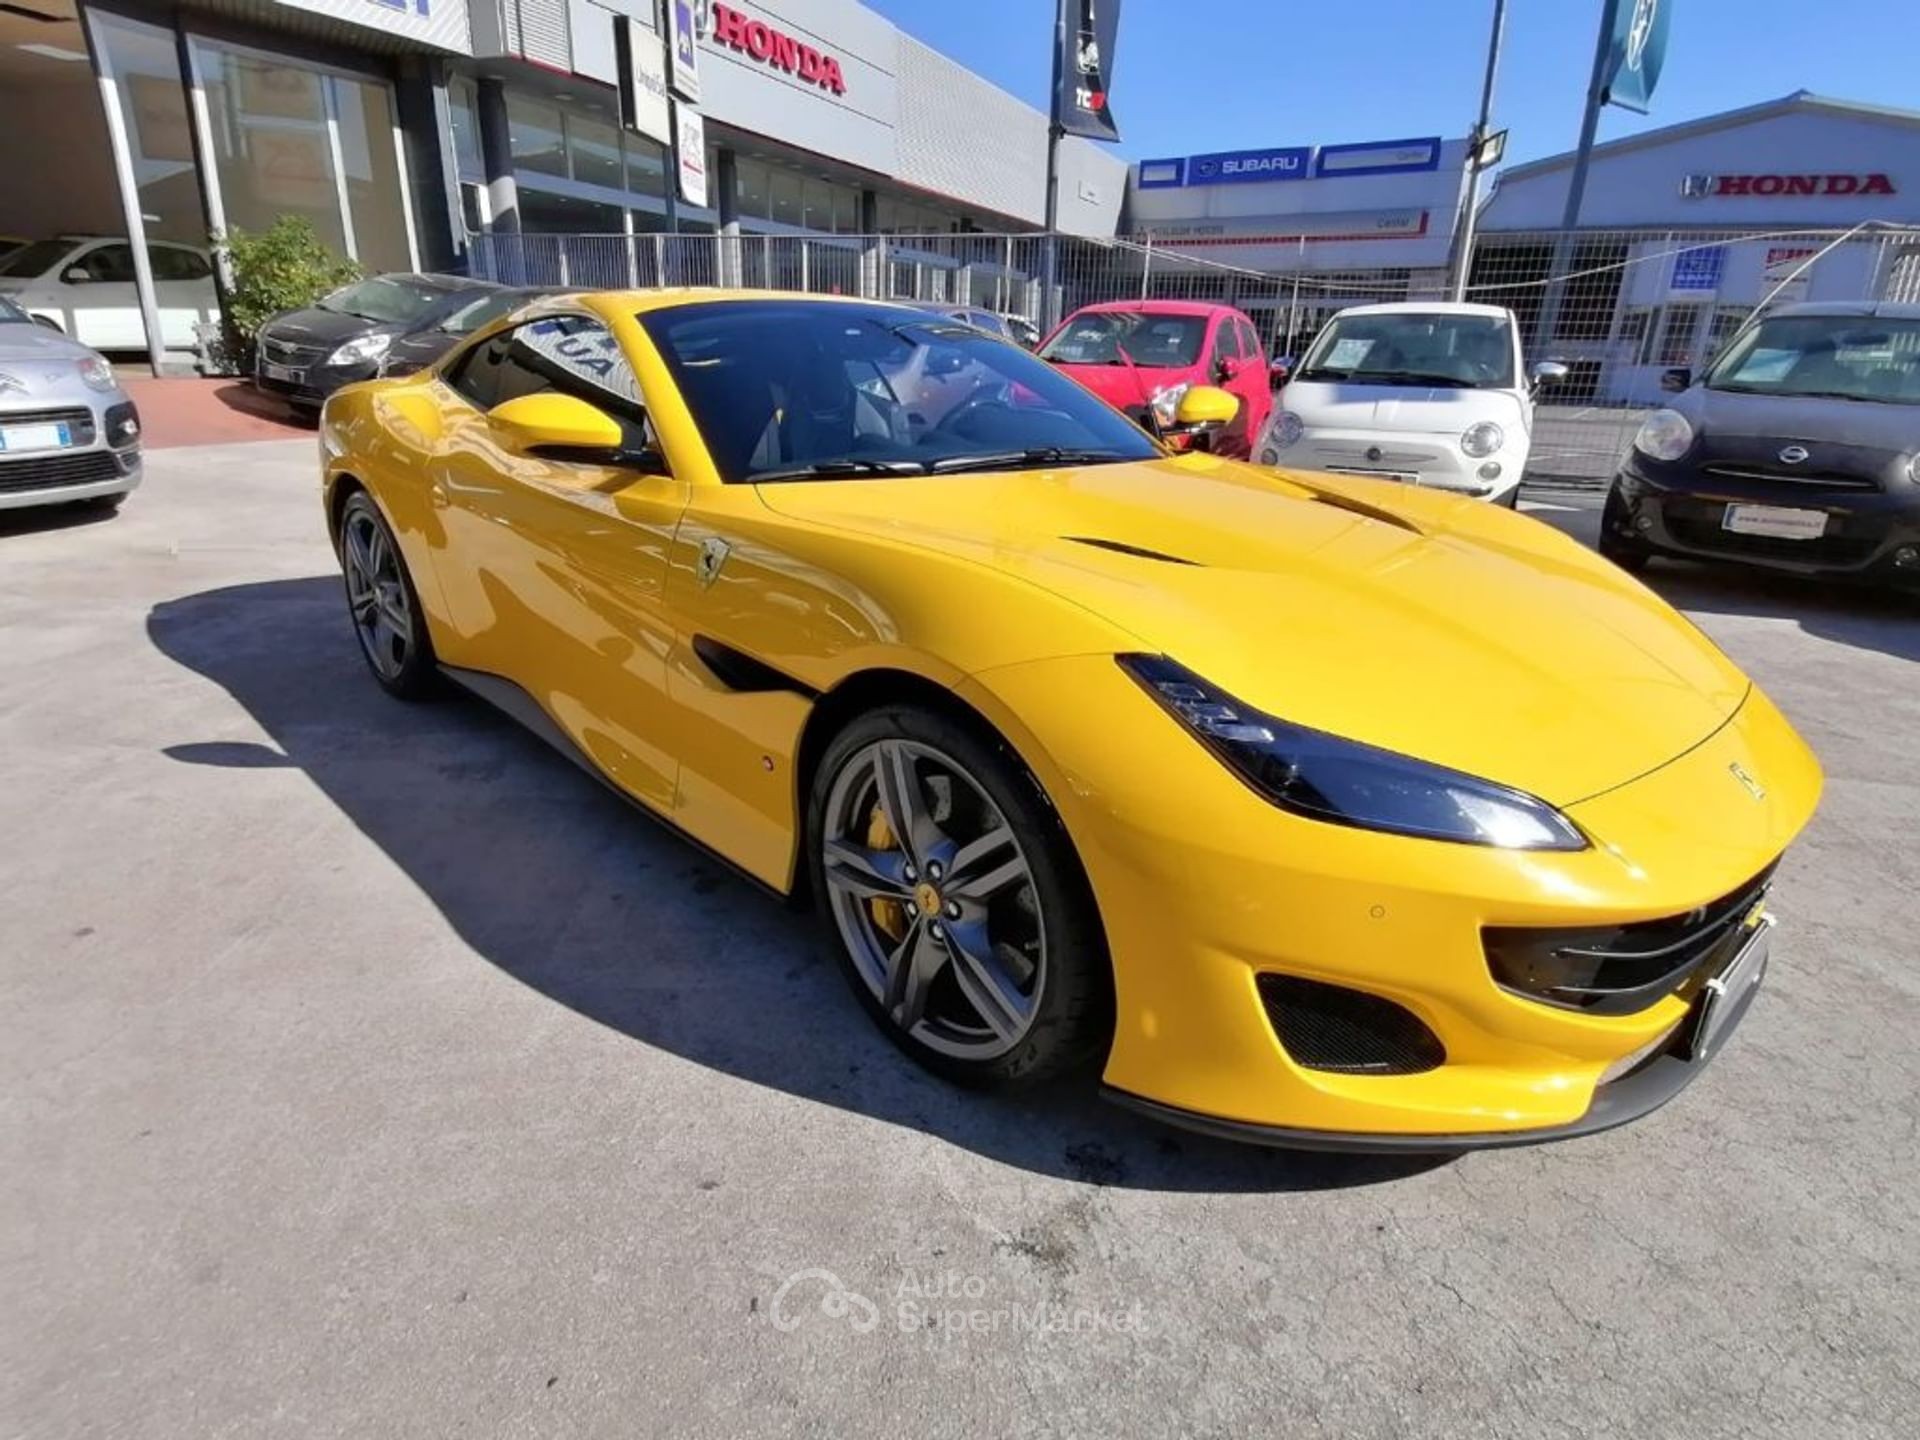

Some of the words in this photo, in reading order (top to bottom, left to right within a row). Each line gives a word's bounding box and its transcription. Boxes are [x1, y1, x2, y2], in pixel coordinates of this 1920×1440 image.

[714, 3, 846, 96] HONDA
[1222, 157, 1299, 174] SUBARU
[1714, 174, 1897, 196] HONDA
